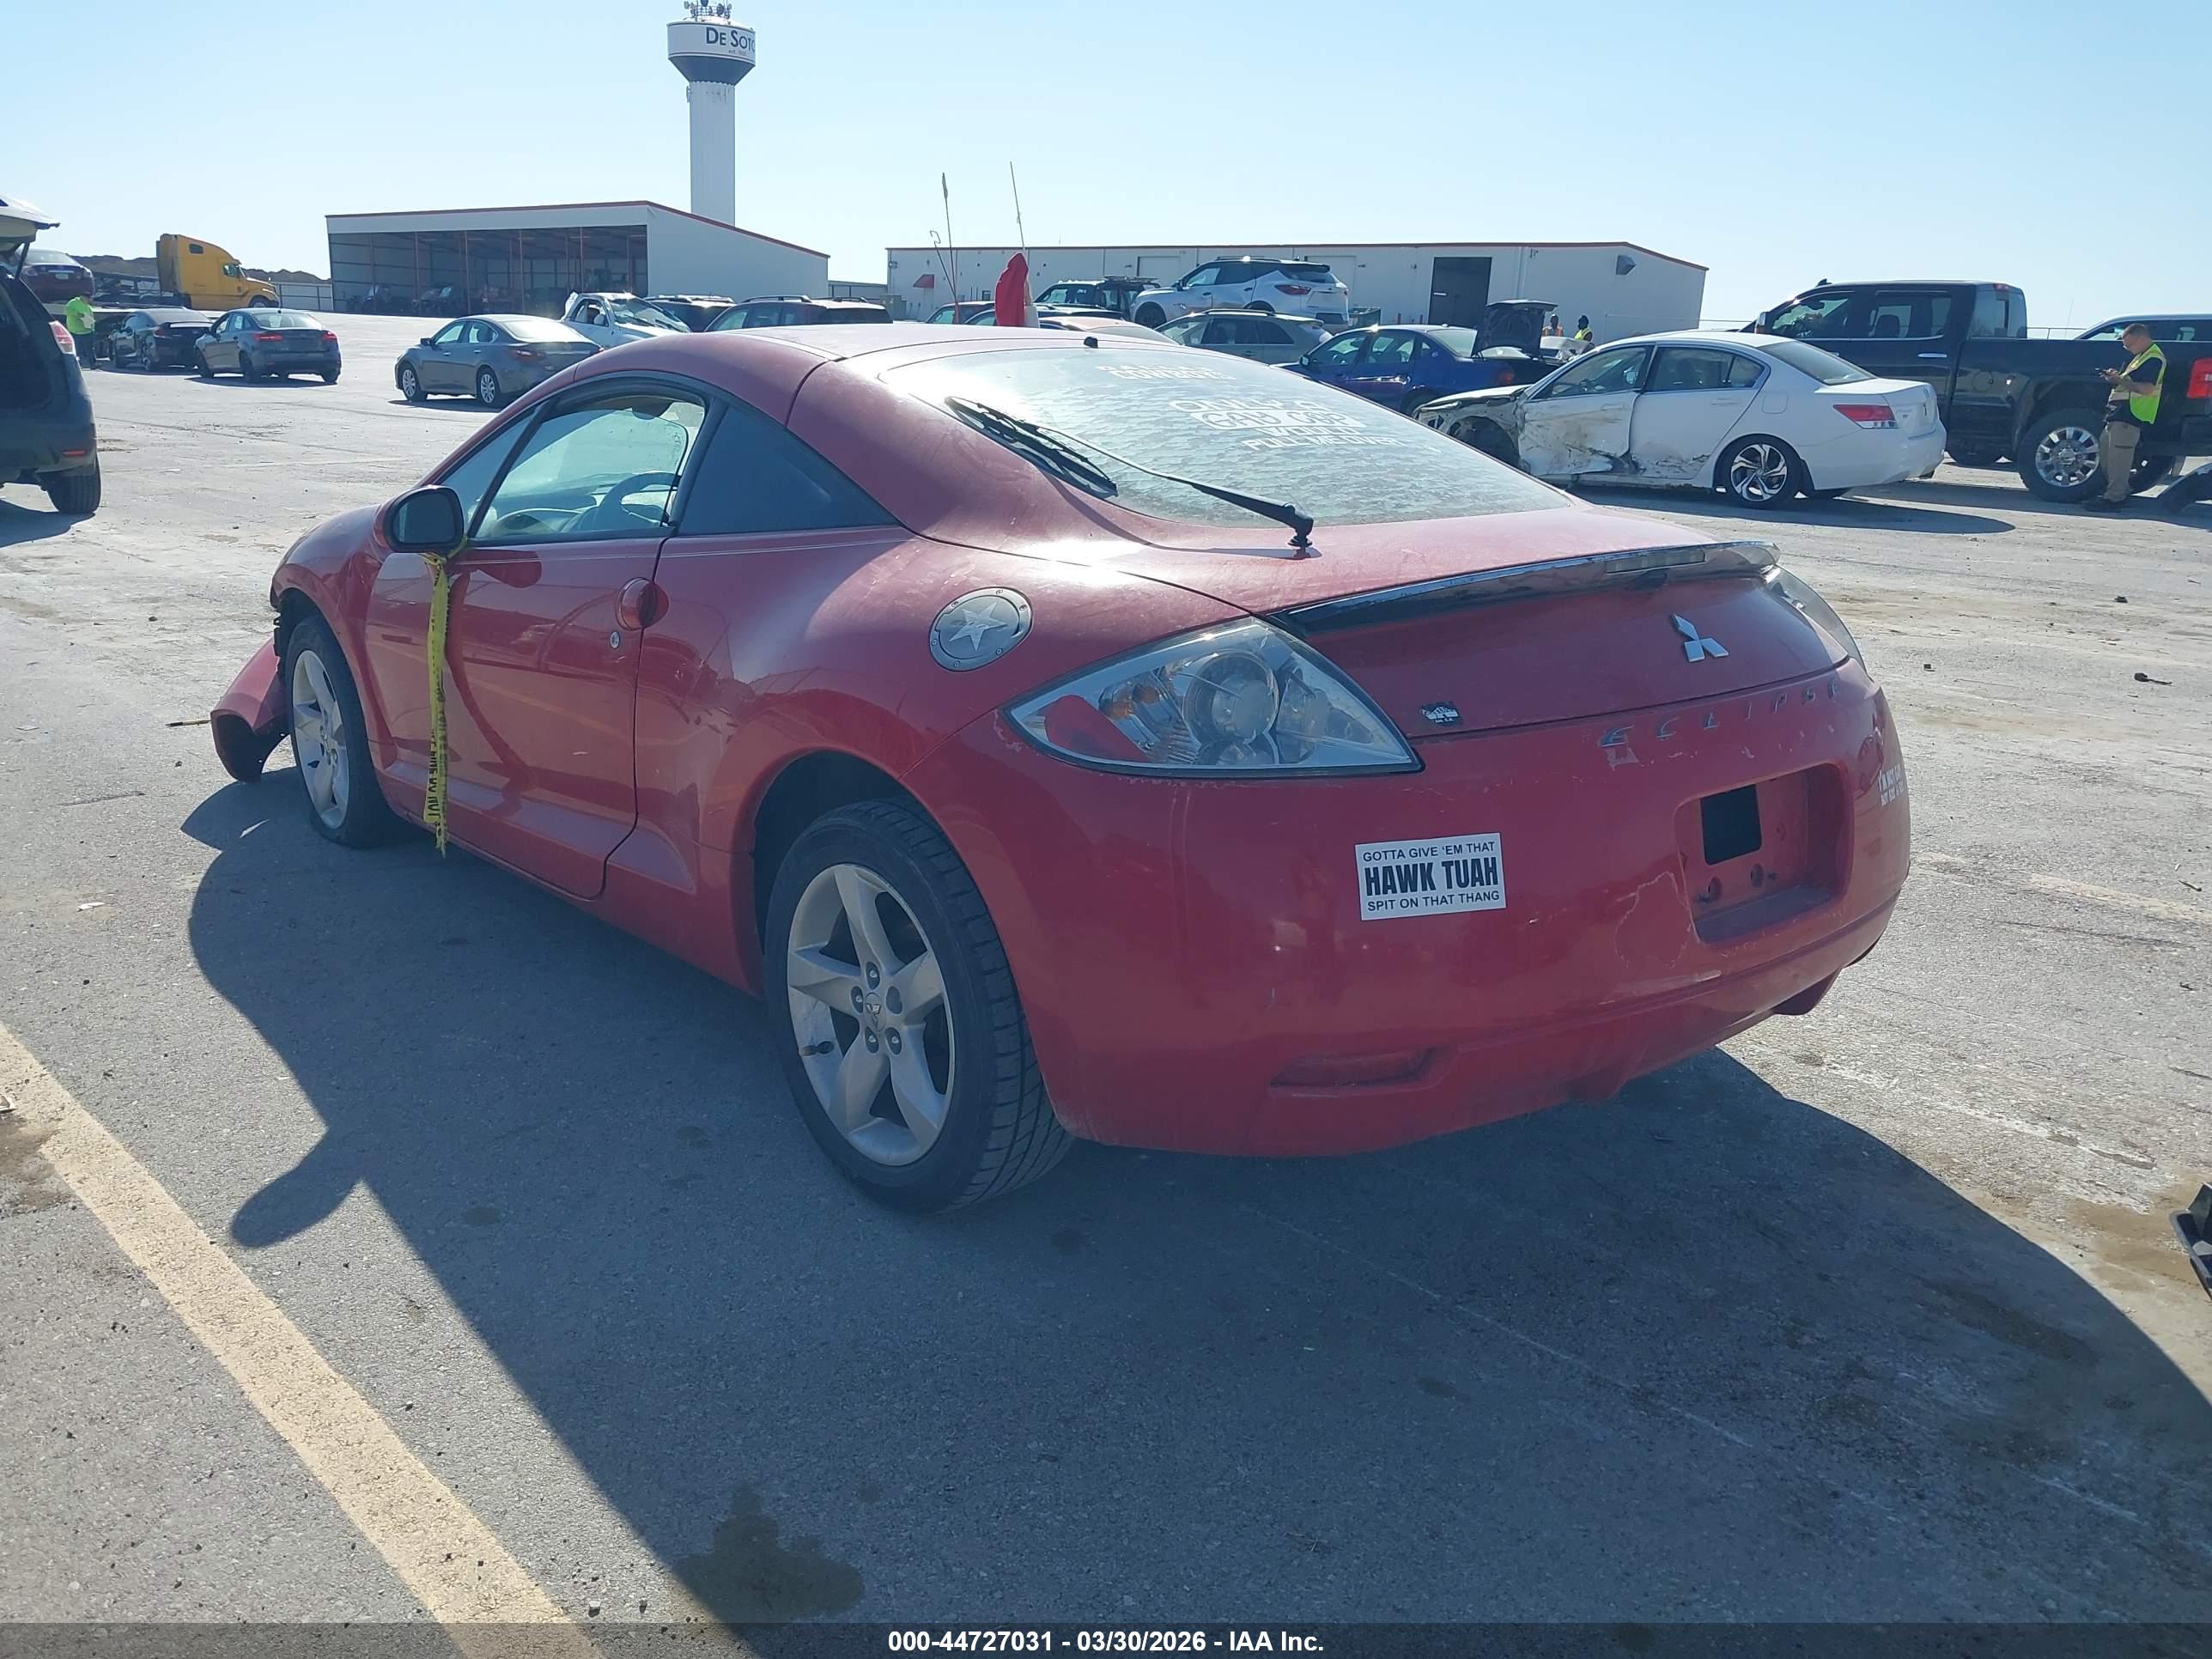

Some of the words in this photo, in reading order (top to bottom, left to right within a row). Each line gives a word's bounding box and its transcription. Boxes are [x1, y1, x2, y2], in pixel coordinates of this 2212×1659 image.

[706, 27, 726, 46] DE
[1168, 398, 1284, 412] ONLY
[1293, 400, 1332, 412] A
[1200, 411, 1282, 428] GAY
[1286, 410, 1350, 426] COP
[1254, 426, 1361, 437] WOULD
[1241, 437, 1310, 451] PULL
[1304, 435, 1342, 447] ME
[1336, 434, 1408, 448] OVER
[1363, 849, 1406, 862] GOTTA
[1408, 846, 1438, 858] GIVE
[1466, 842, 1495, 854] THAT
[1364, 862, 1437, 896] HAWK
[1441, 857, 1498, 890] TUAH
[1367, 899, 1396, 911] SPIT
[1400, 898, 1419, 908] ON
[1422, 894, 1455, 907] THAT
[1458, 890, 1500, 903] THANG
